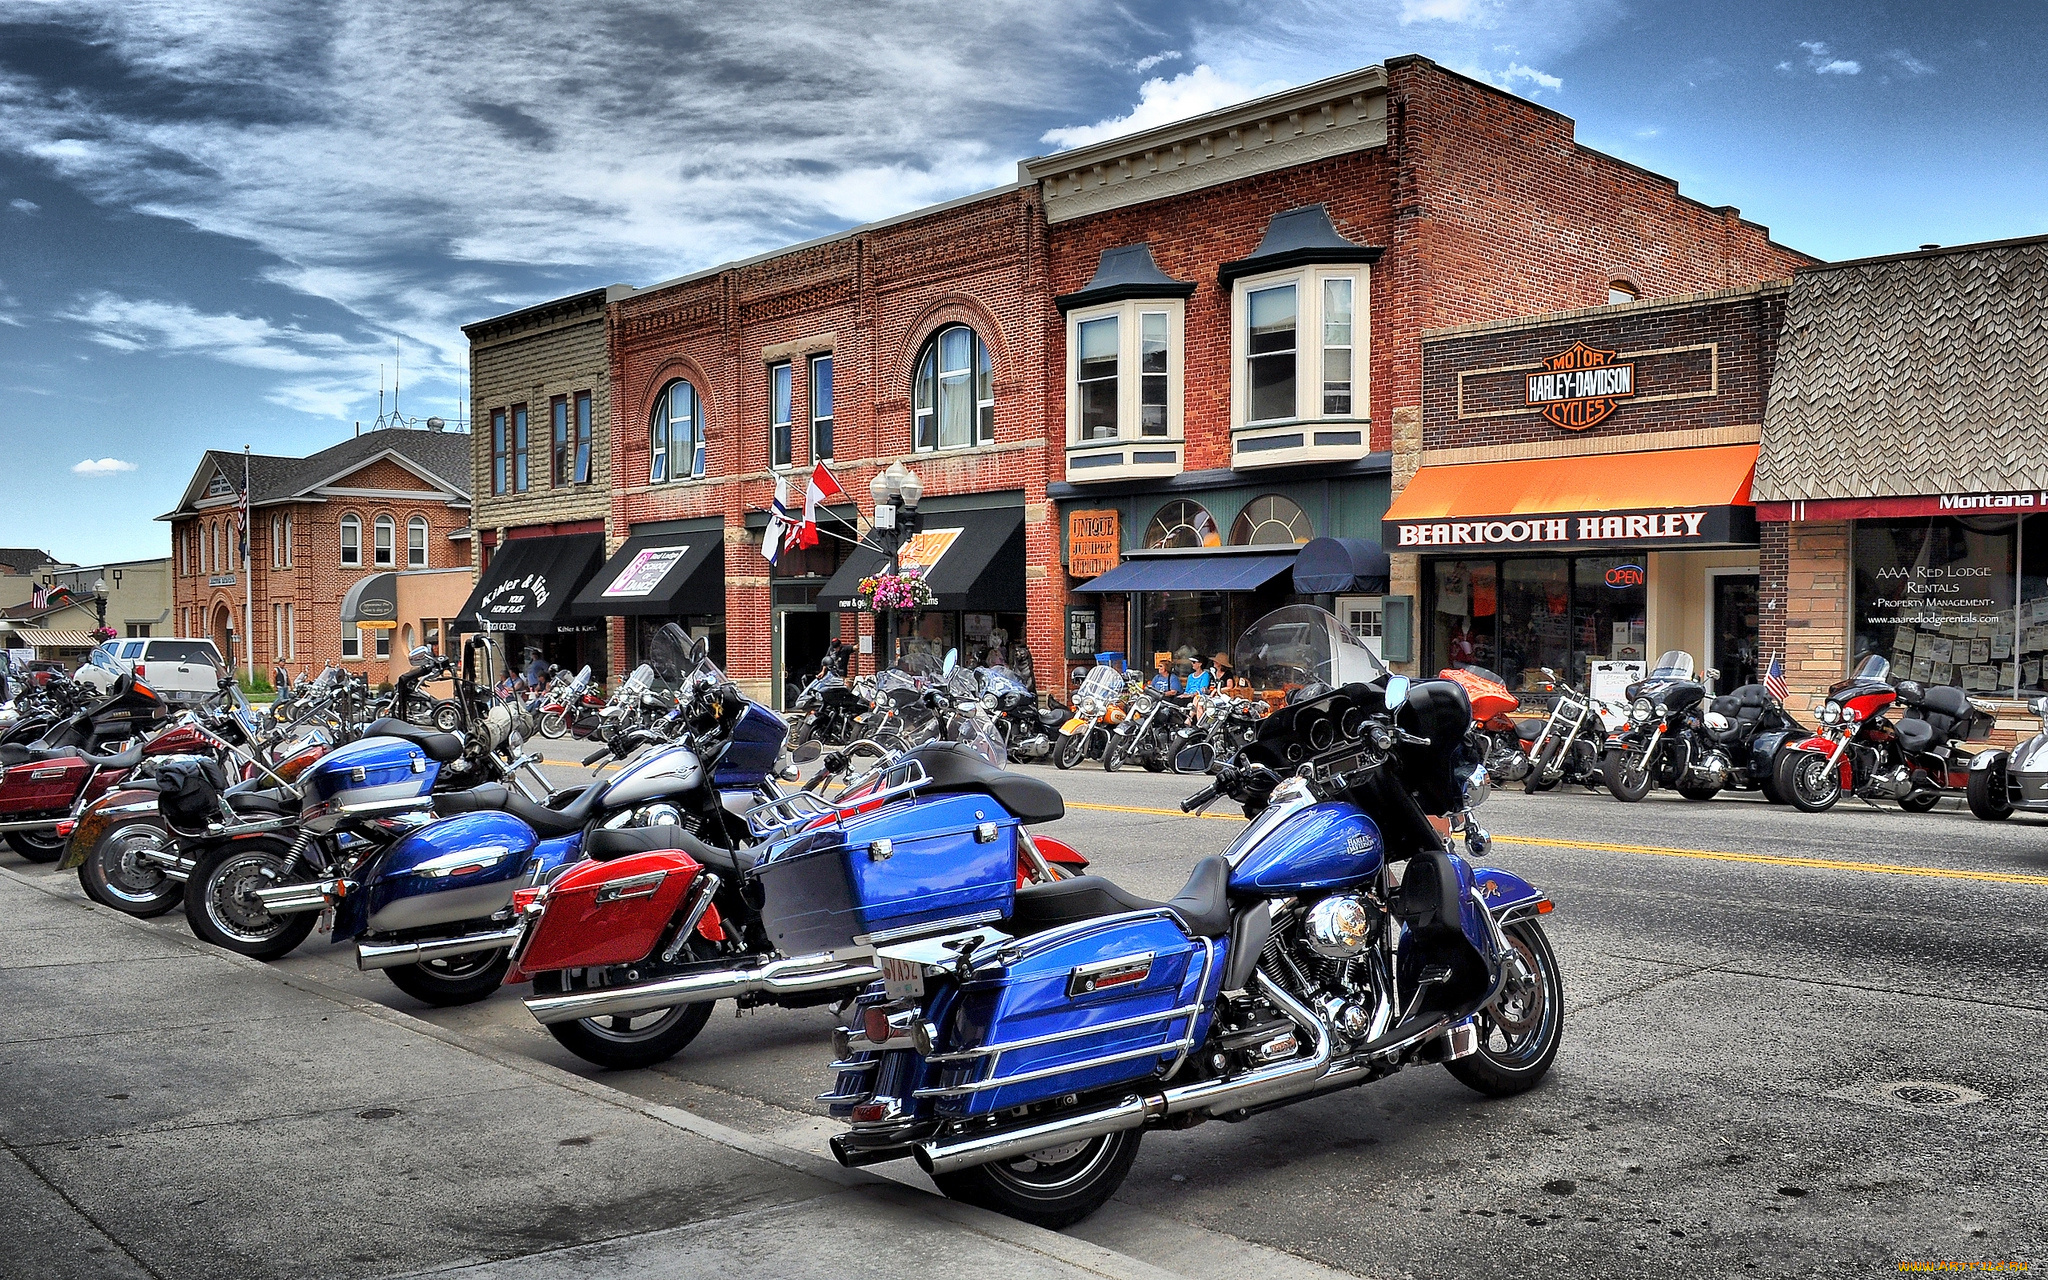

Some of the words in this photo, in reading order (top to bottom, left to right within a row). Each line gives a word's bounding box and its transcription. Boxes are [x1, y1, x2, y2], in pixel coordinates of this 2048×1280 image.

[1553, 352, 1605, 370] MOTOR
[1528, 367, 1631, 403] HARLEY-DAVIDSON
[1551, 400, 1606, 427] CYCLES
[1939, 494, 2034, 509] Montana
[1073, 516, 1114, 537] UNIQUE
[1397, 518, 1570, 546] BEARTOOTH
[1577, 511, 1707, 540] HARLEY
[1072, 540, 1112, 555] JUNIPER
[1605, 568, 1644, 585] OPEN
[1875, 567, 1910, 579] AAA
[481, 578, 521, 609] Kibler
[521, 573, 535, 589] &
[1867, 612, 1999, 626] www.aaaredlodgerentals.com
